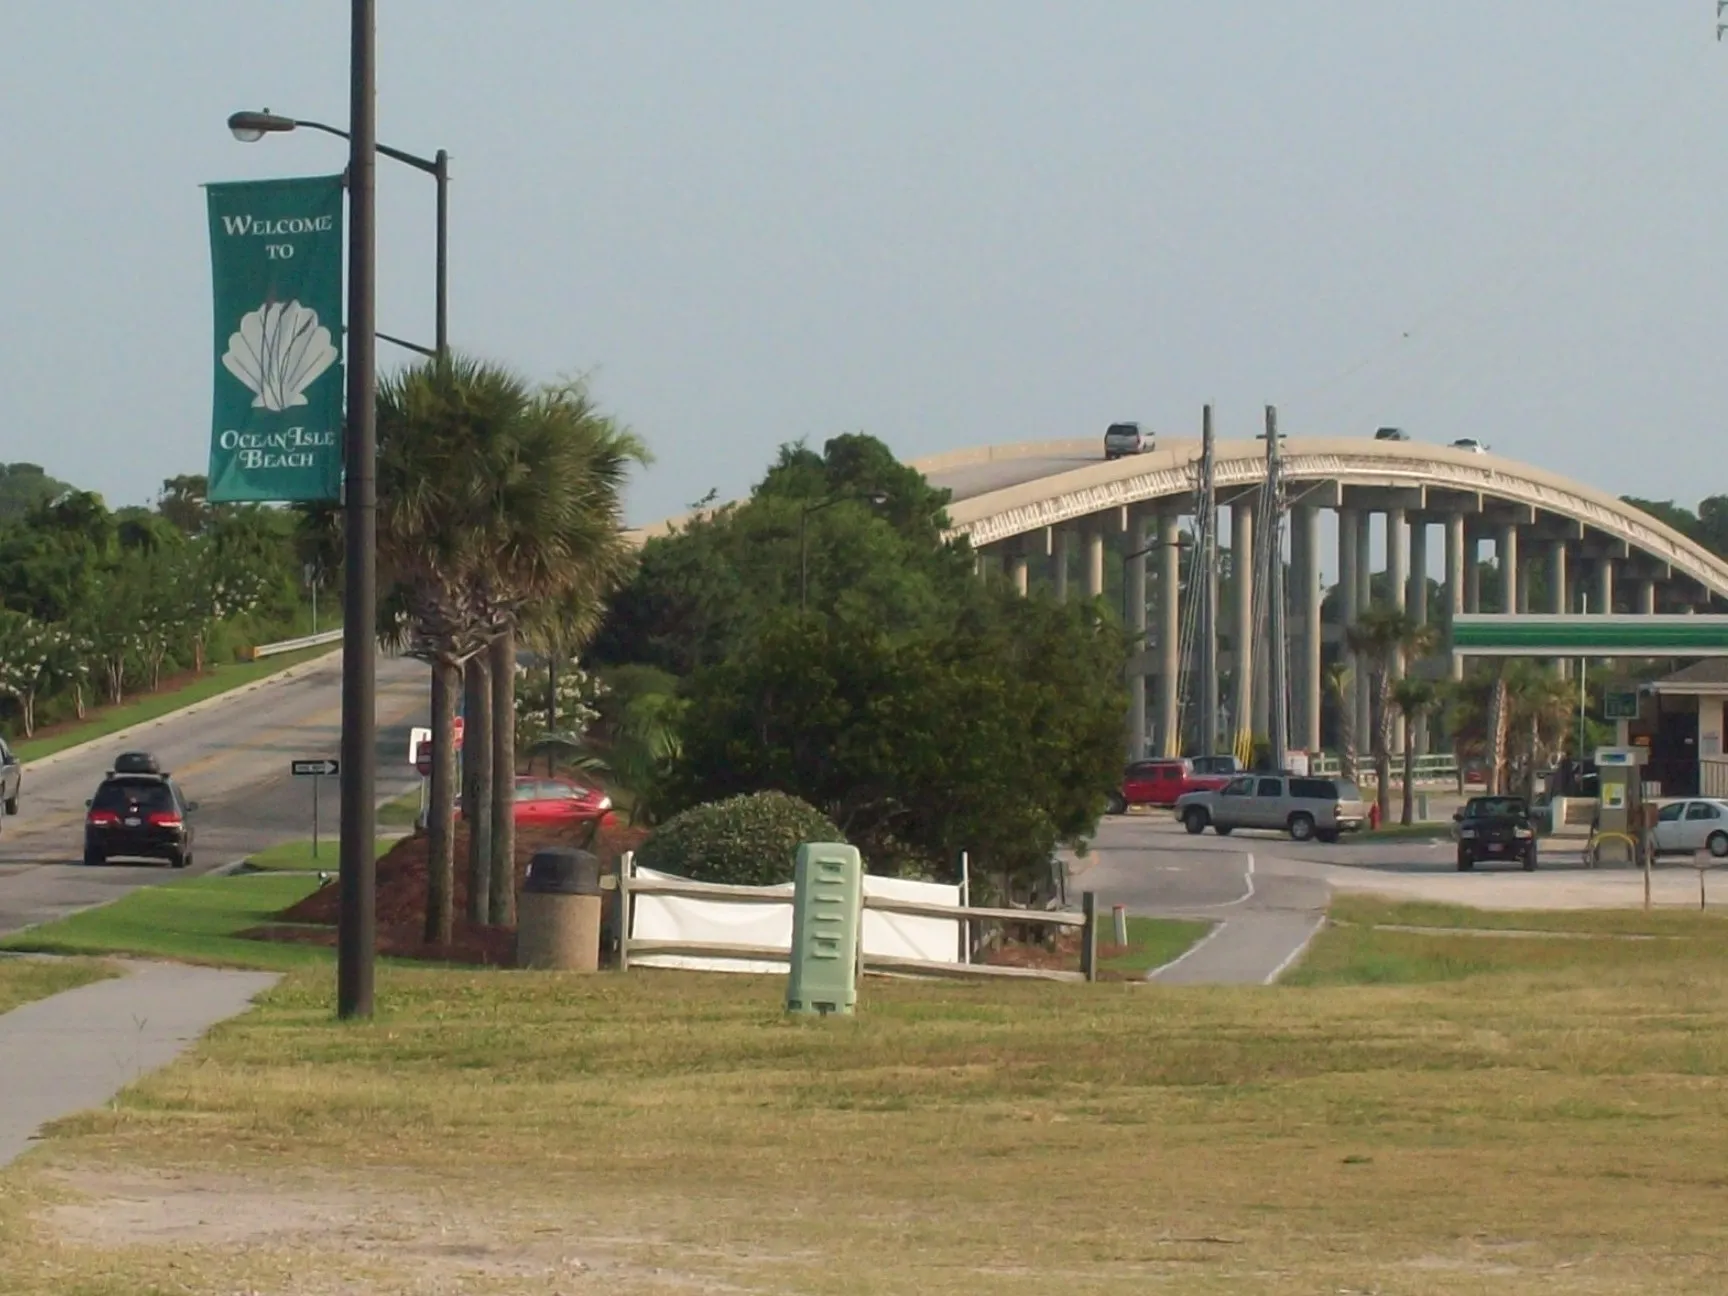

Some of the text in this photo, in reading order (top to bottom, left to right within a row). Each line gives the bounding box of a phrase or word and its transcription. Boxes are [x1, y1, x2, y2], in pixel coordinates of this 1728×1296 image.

[222, 214, 332, 236] WELCOME
[265, 243, 294, 259] TO
[220, 426, 334, 452] OCEAN ISLE
[239, 449, 314, 468] BEACH
